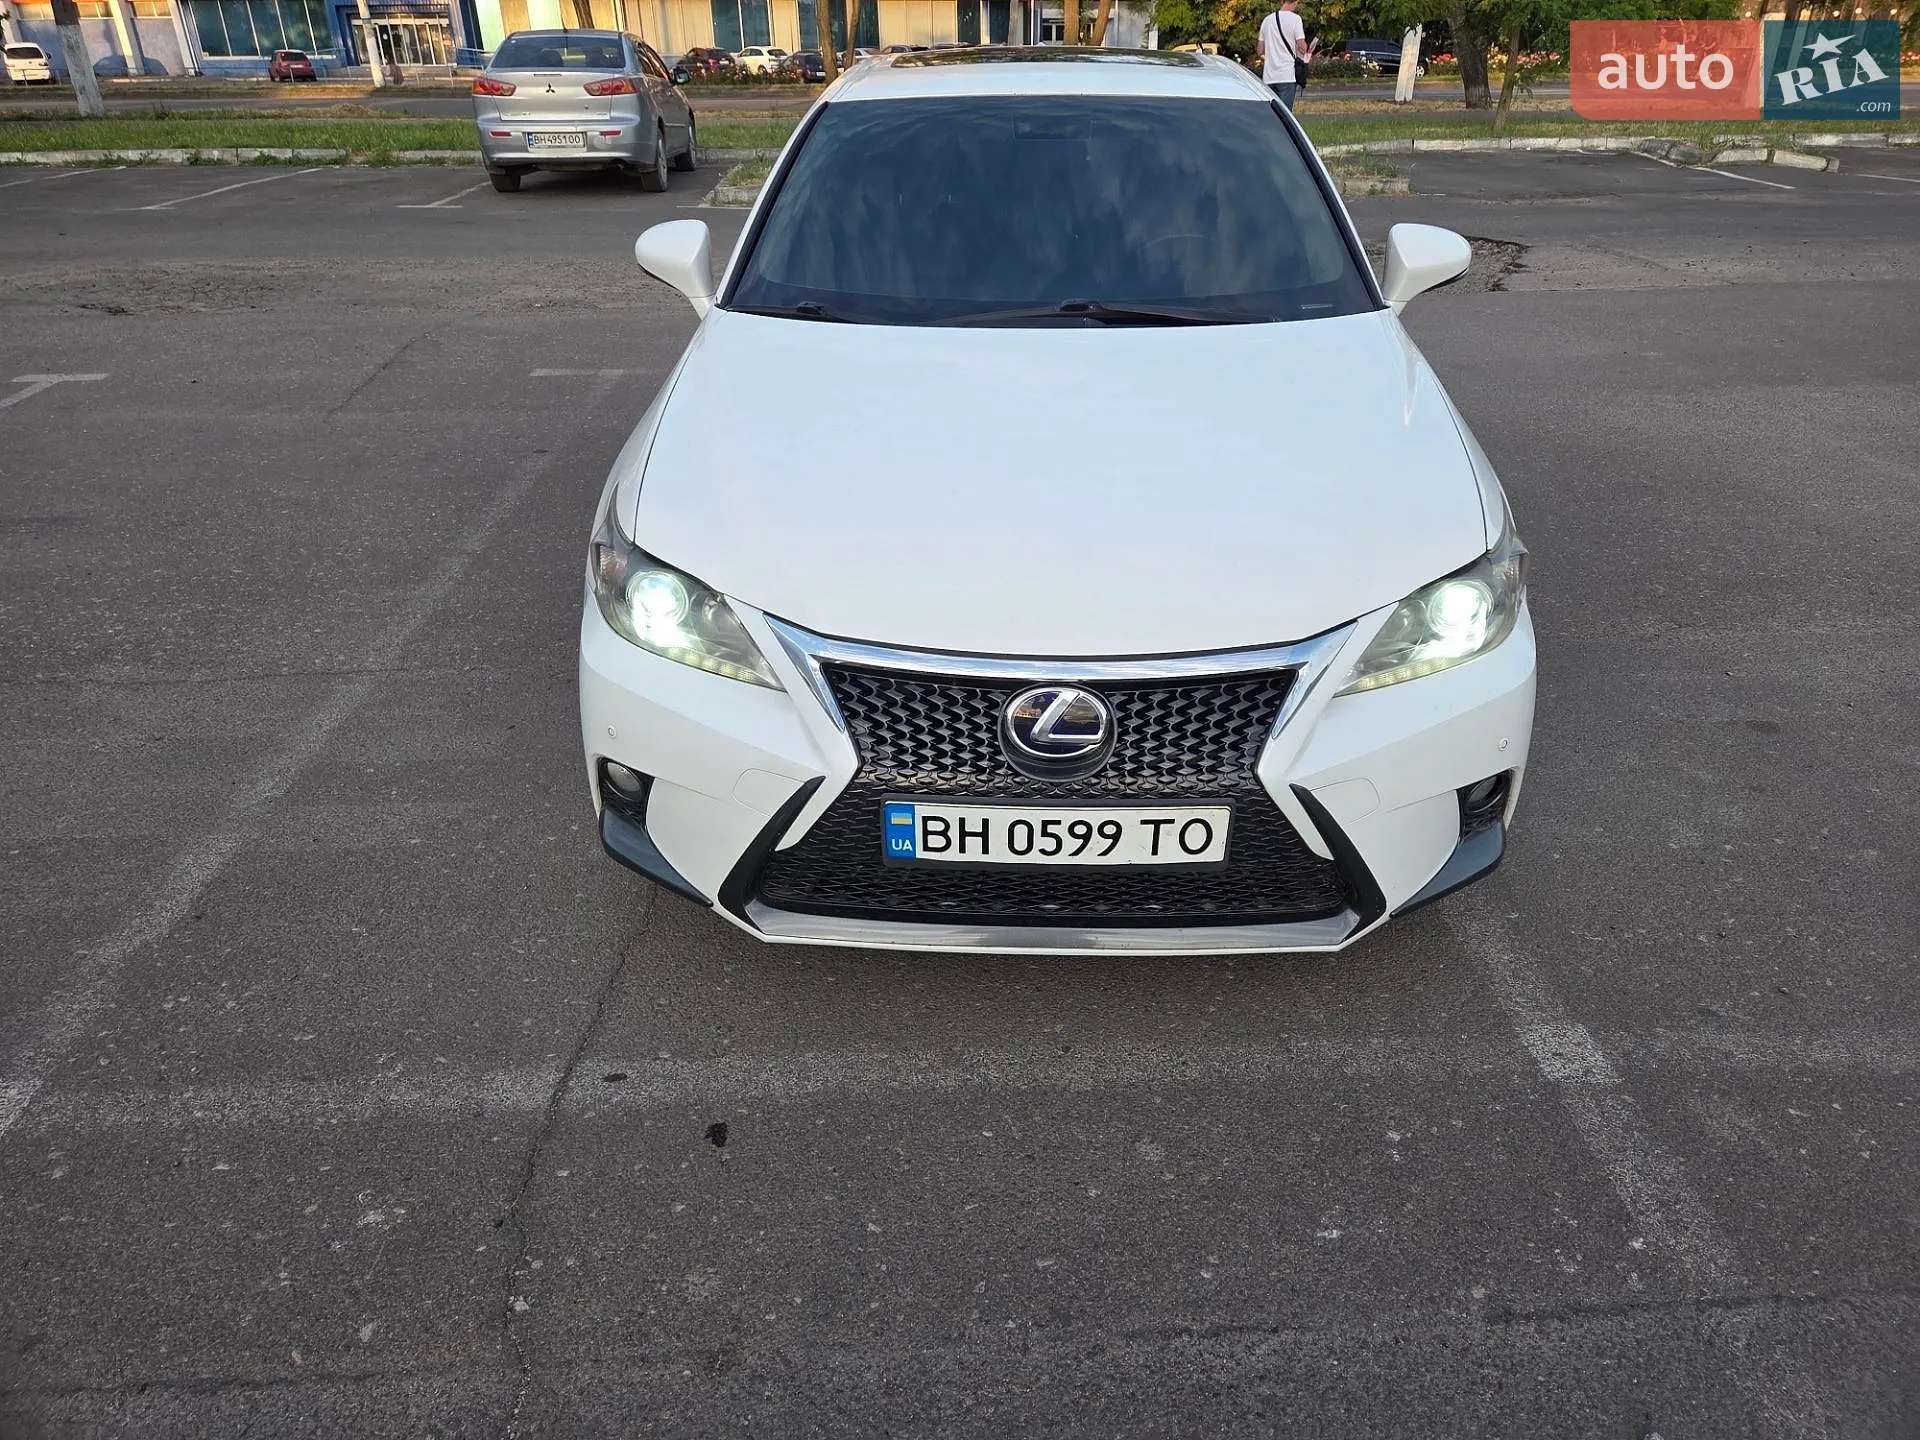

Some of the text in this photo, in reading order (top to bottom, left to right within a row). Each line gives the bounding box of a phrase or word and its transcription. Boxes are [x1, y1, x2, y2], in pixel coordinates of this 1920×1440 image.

[533, 135, 546, 145] BH
[921, 815, 1214, 857] BH 0599 TO
[892, 838, 913, 851] UA
